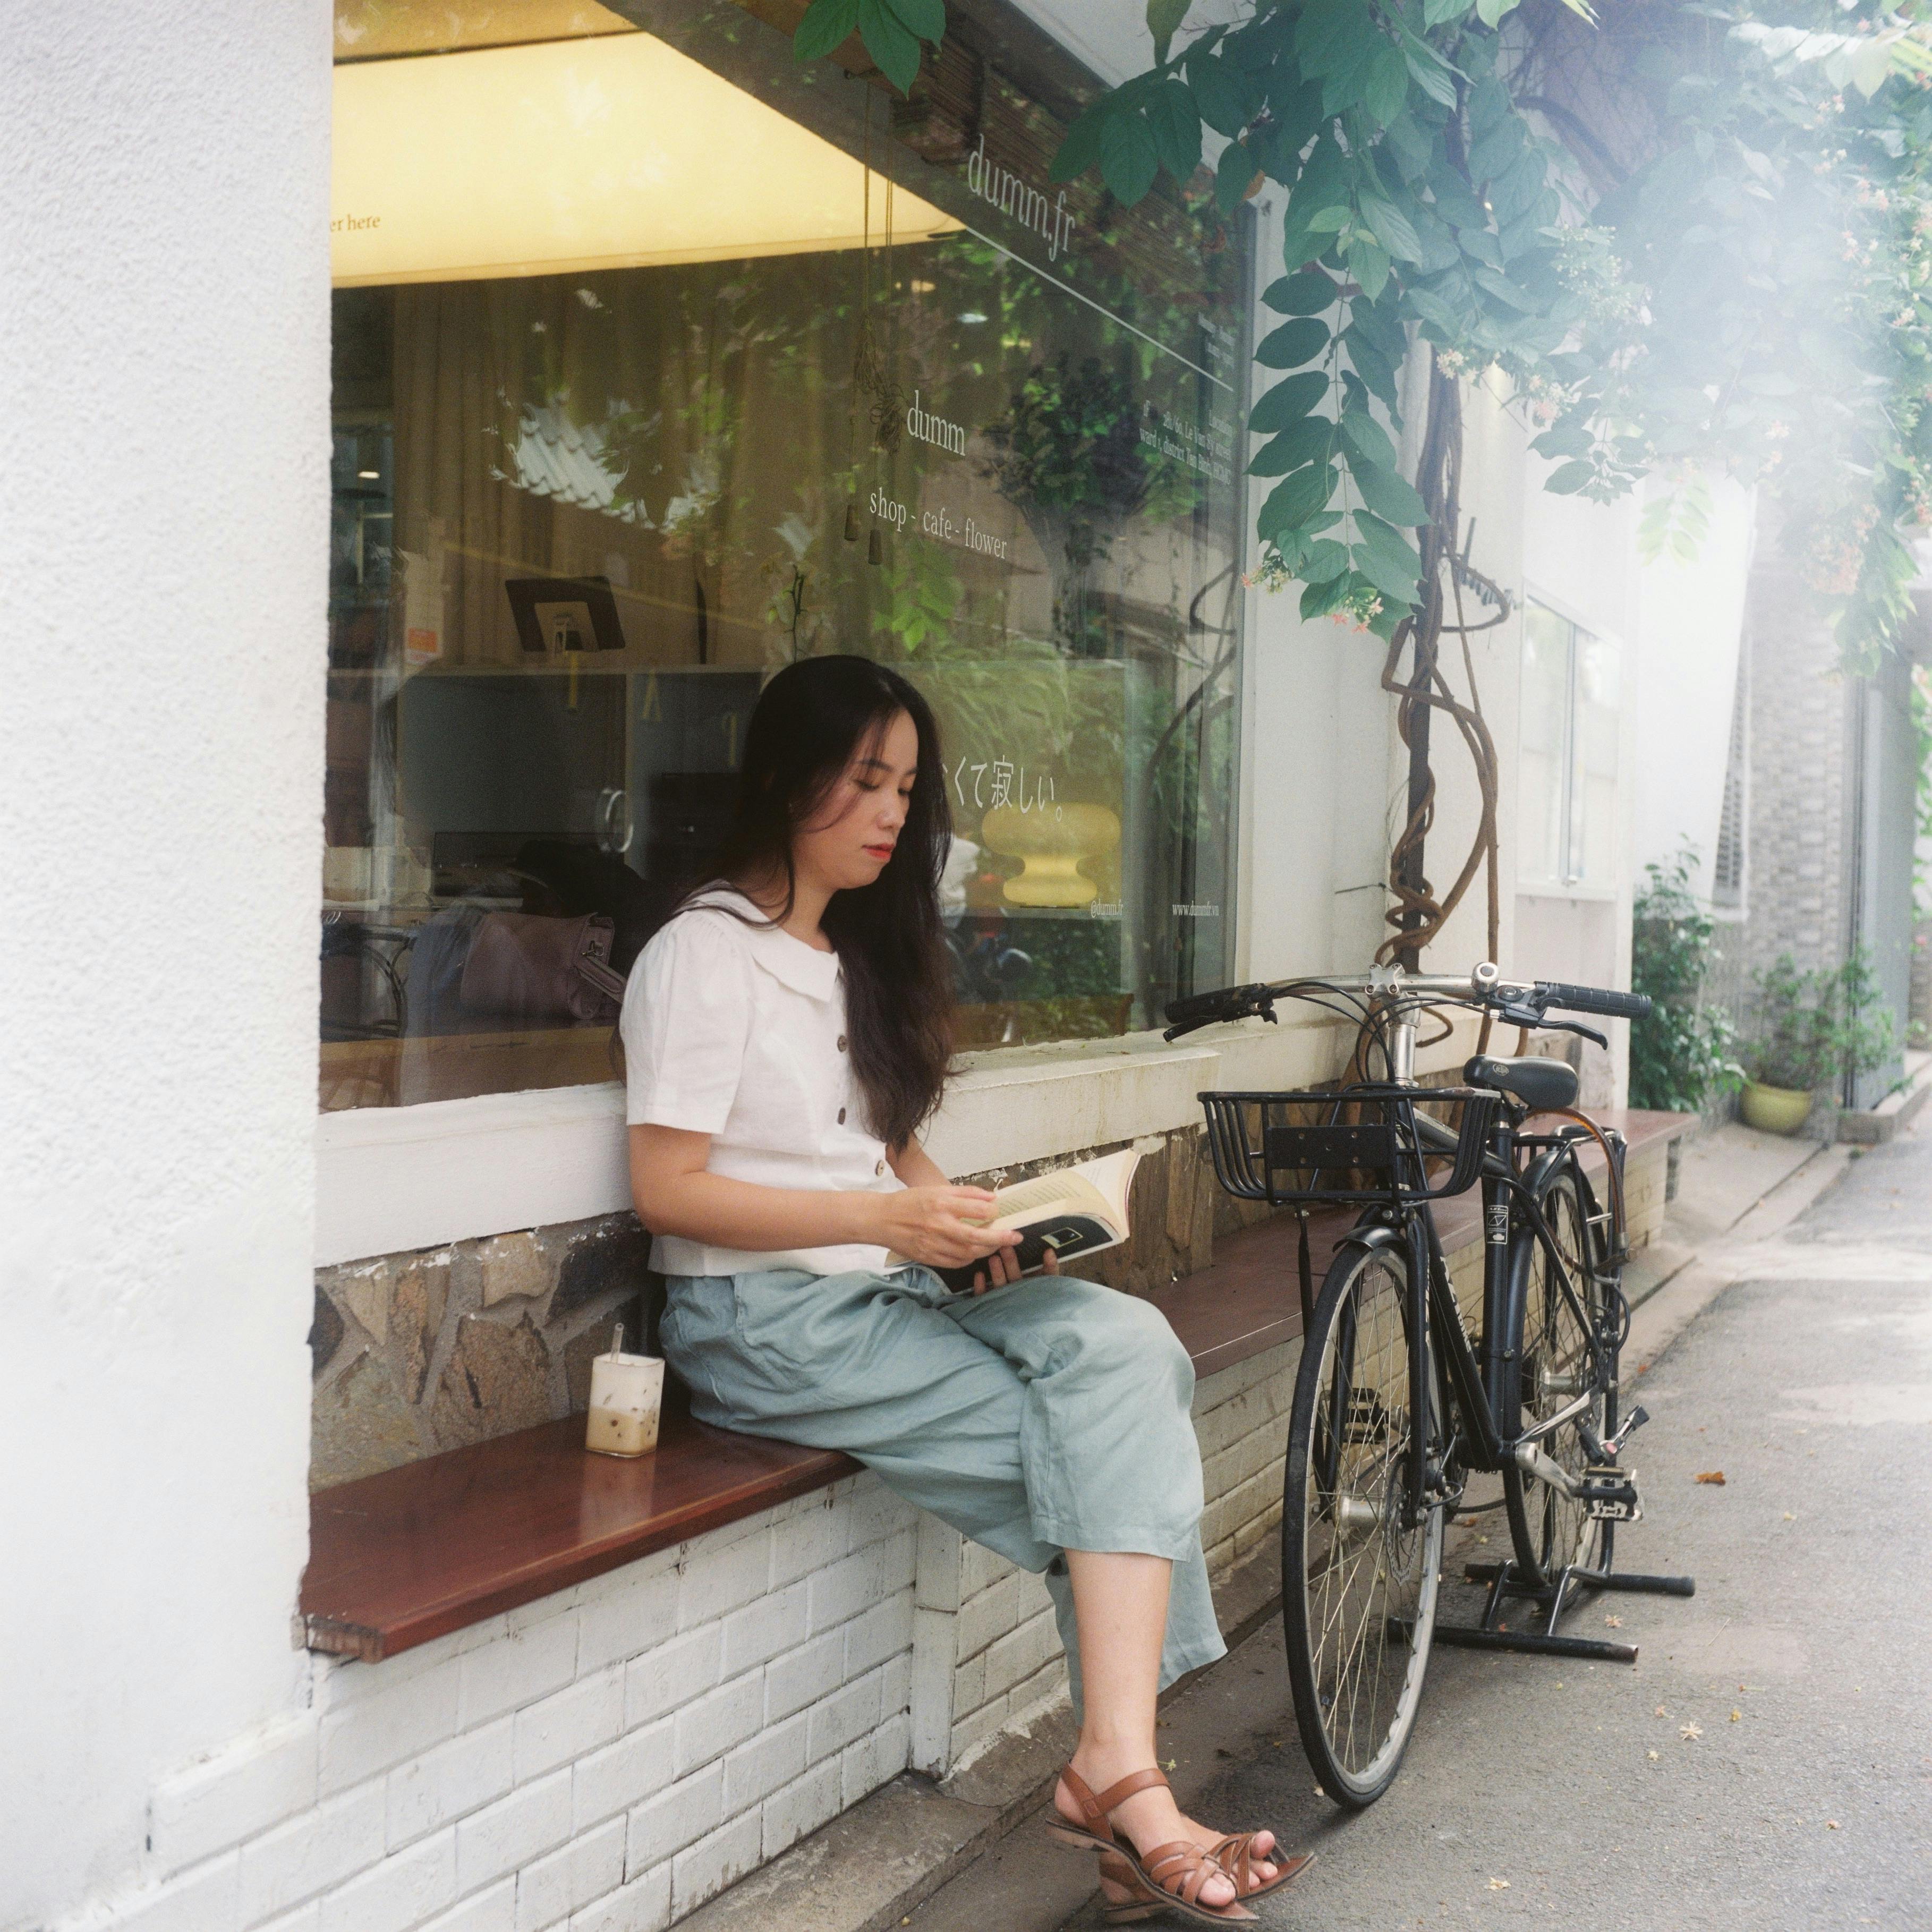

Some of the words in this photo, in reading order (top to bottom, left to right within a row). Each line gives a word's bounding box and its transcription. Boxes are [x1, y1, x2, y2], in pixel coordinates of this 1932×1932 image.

[347, 214, 381, 230] here
[968, 133, 1076, 261] dumm.fr
[907, 389, 965, 456] dumm
[1139, 428, 1156, 448] ward
[870, 487, 906, 532] shop
[923, 507, 952, 539] cafe
[965, 517, 1007, 559] flower
[942, 754, 1062, 822] くて寂しい。
[1091, 898, 1124, 918] @dumm.fr
